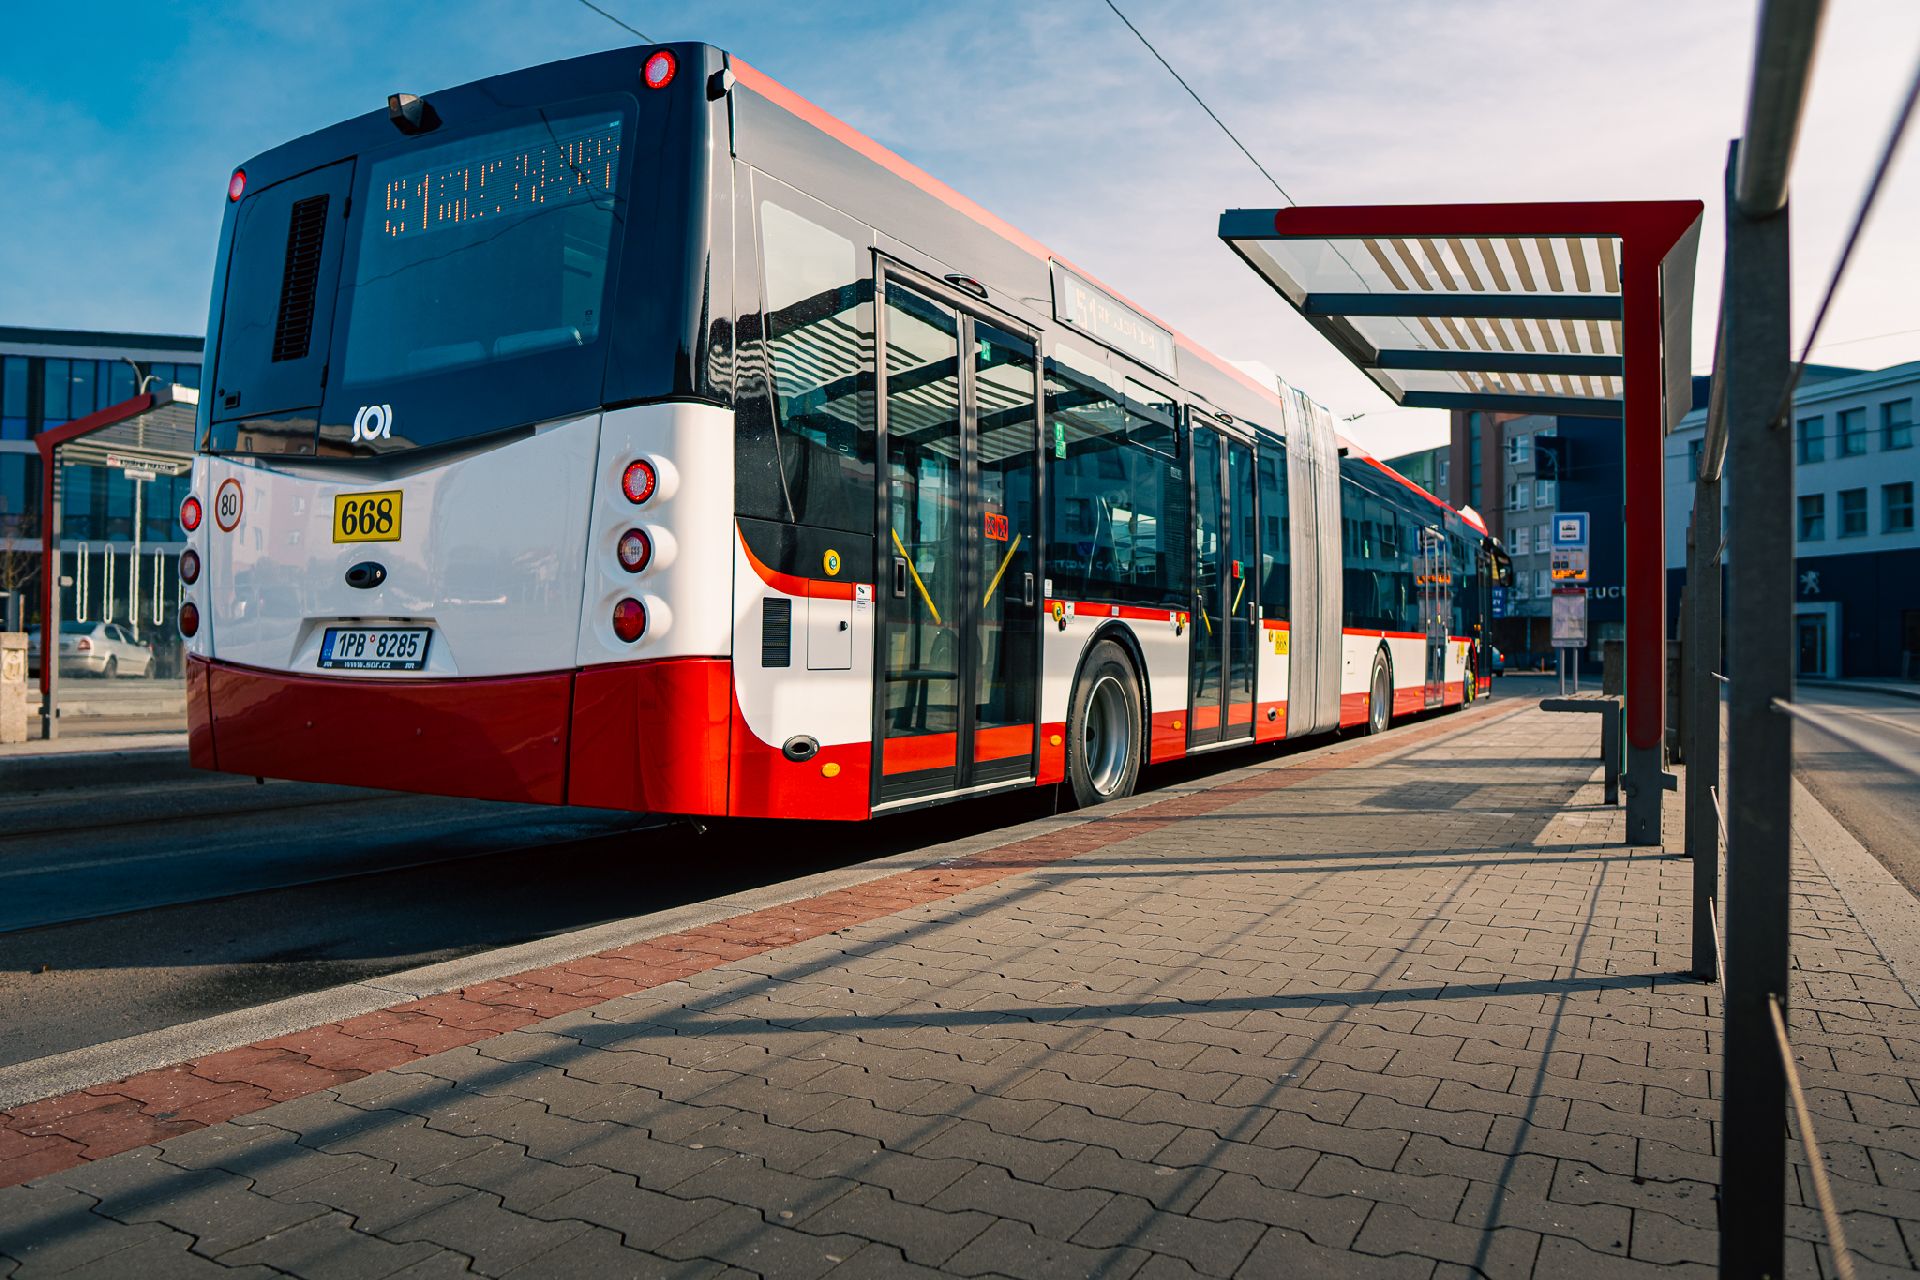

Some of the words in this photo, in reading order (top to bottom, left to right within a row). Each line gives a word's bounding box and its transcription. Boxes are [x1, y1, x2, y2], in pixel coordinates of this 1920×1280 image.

[221, 493, 237, 517] 80
[341, 498, 393, 535] 668
[339, 633, 367, 657] 1PB
[376, 633, 420, 658] 8285
